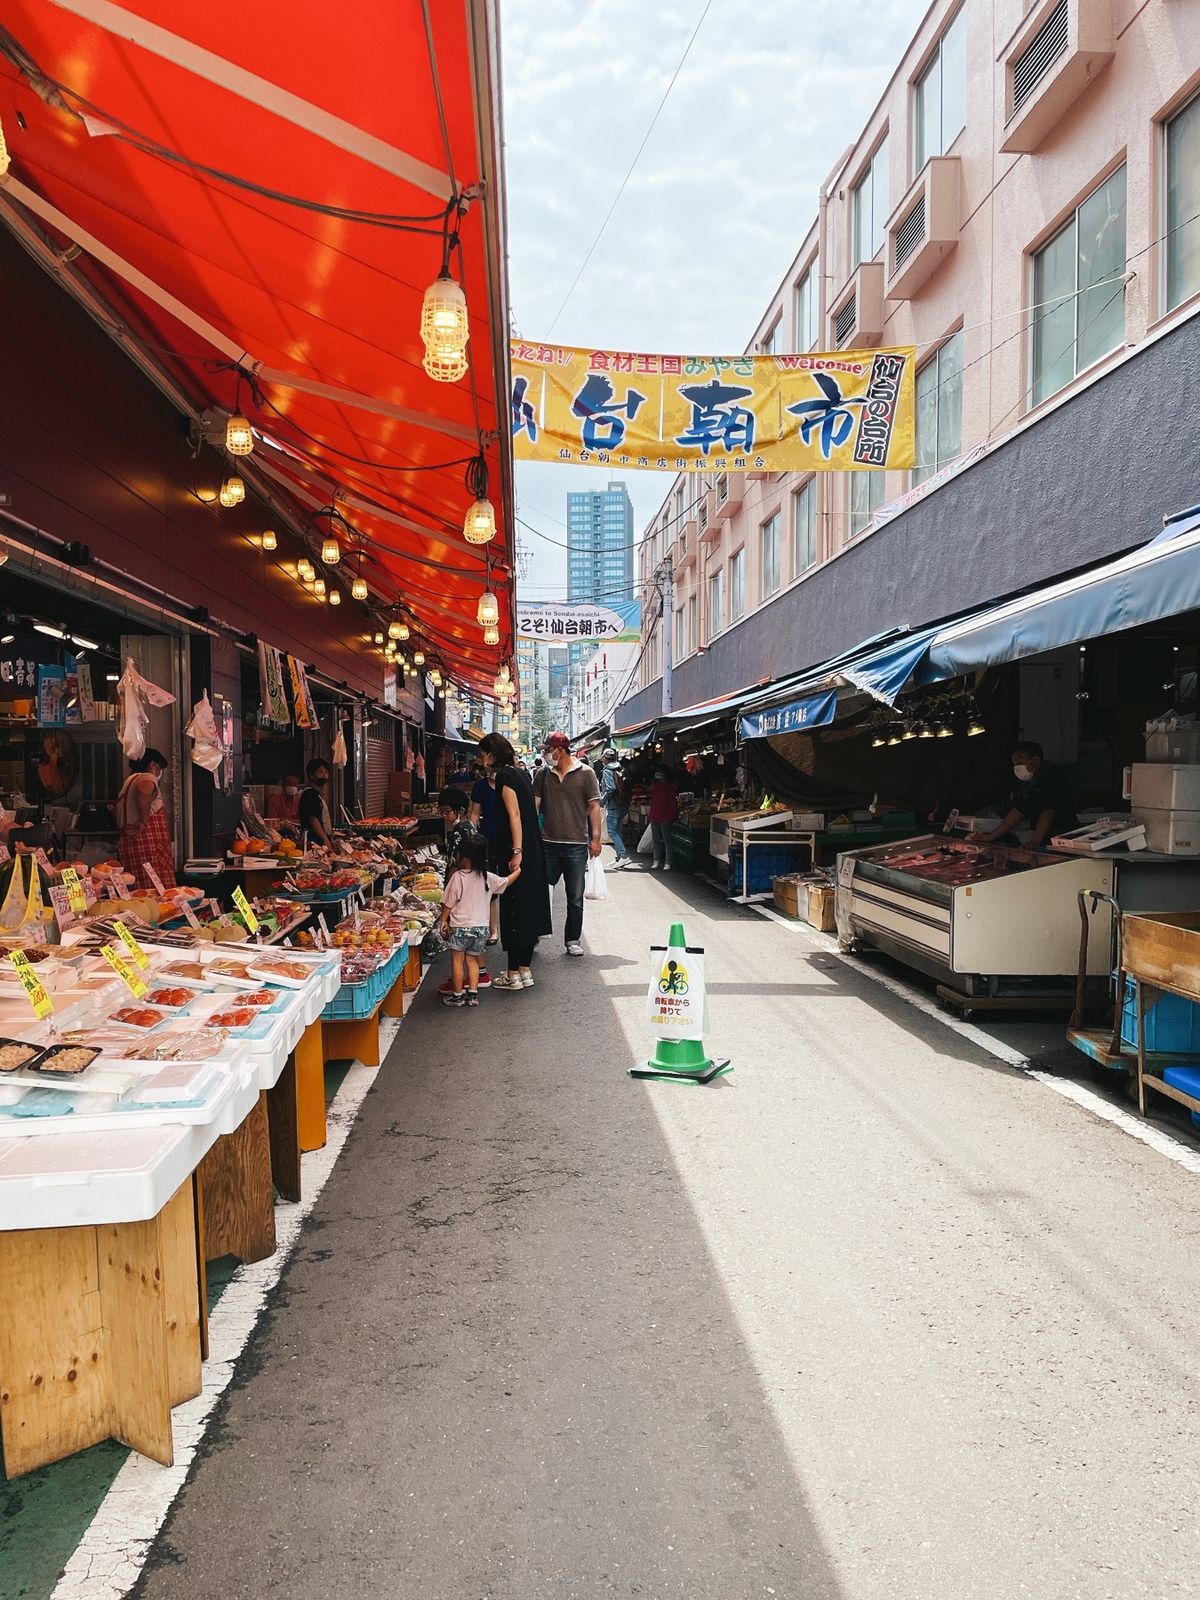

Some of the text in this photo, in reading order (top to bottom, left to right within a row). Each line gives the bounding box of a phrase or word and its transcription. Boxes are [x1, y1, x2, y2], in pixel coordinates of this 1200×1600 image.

[588, 350, 754, 377] 食材王国みやぎ
[781, 356, 863, 374] Welcome
[857, 357, 901, 462] 仙台の台所
[559, 449, 765, 468] 仙台朝市商店街振興組合
[516, 618, 618, 635] こそ!仙台朝市へ
[655, 997, 690, 1006] 自転車から
[660, 1007, 682, 1015] 降りて
